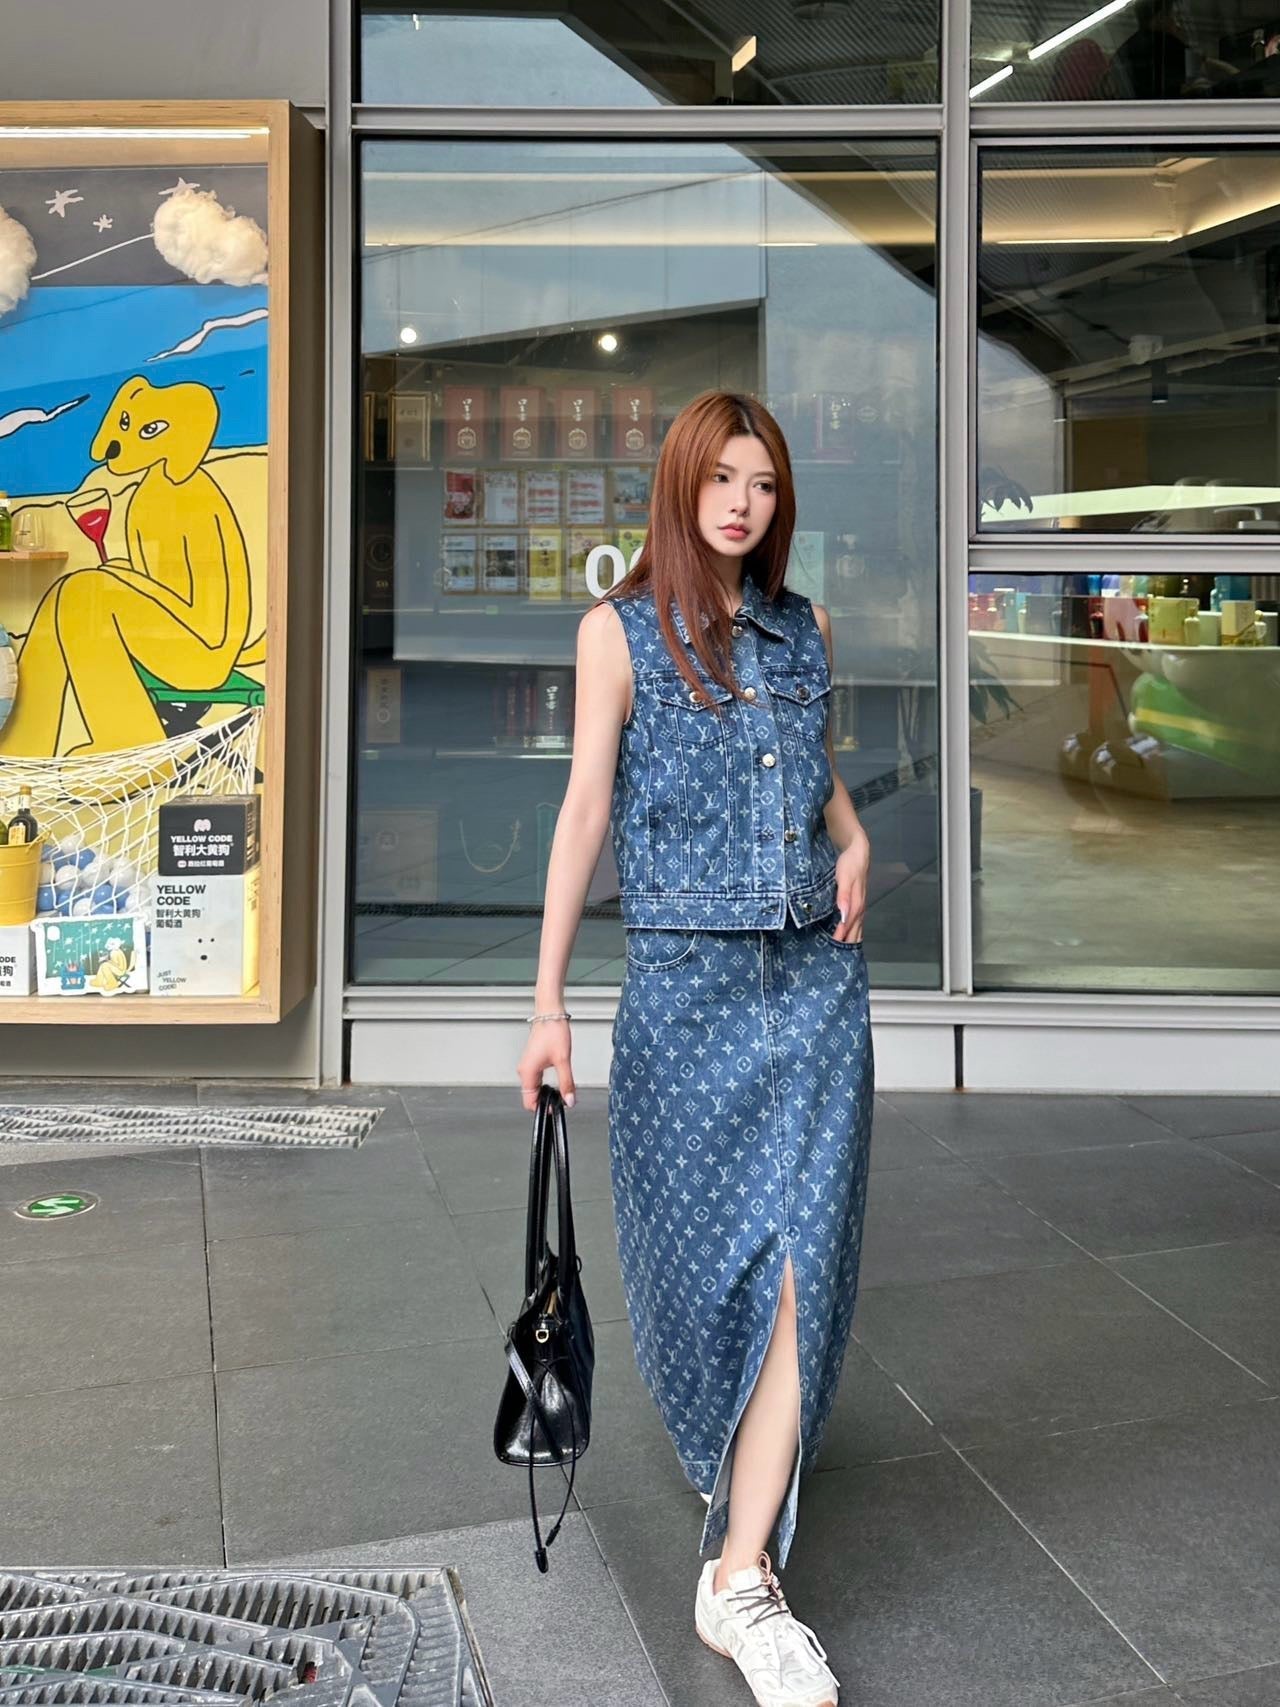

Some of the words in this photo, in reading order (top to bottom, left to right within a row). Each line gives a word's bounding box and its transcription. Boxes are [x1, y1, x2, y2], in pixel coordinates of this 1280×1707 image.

[170, 834, 207, 843] YELLOW
[208, 834, 233, 843] CODE
[172, 843, 231, 856] 智利大黄狗
[156, 884, 206, 894] YELLOW
[156, 896, 191, 905] CODE
[155, 908, 201, 918] 智利大黄狗
